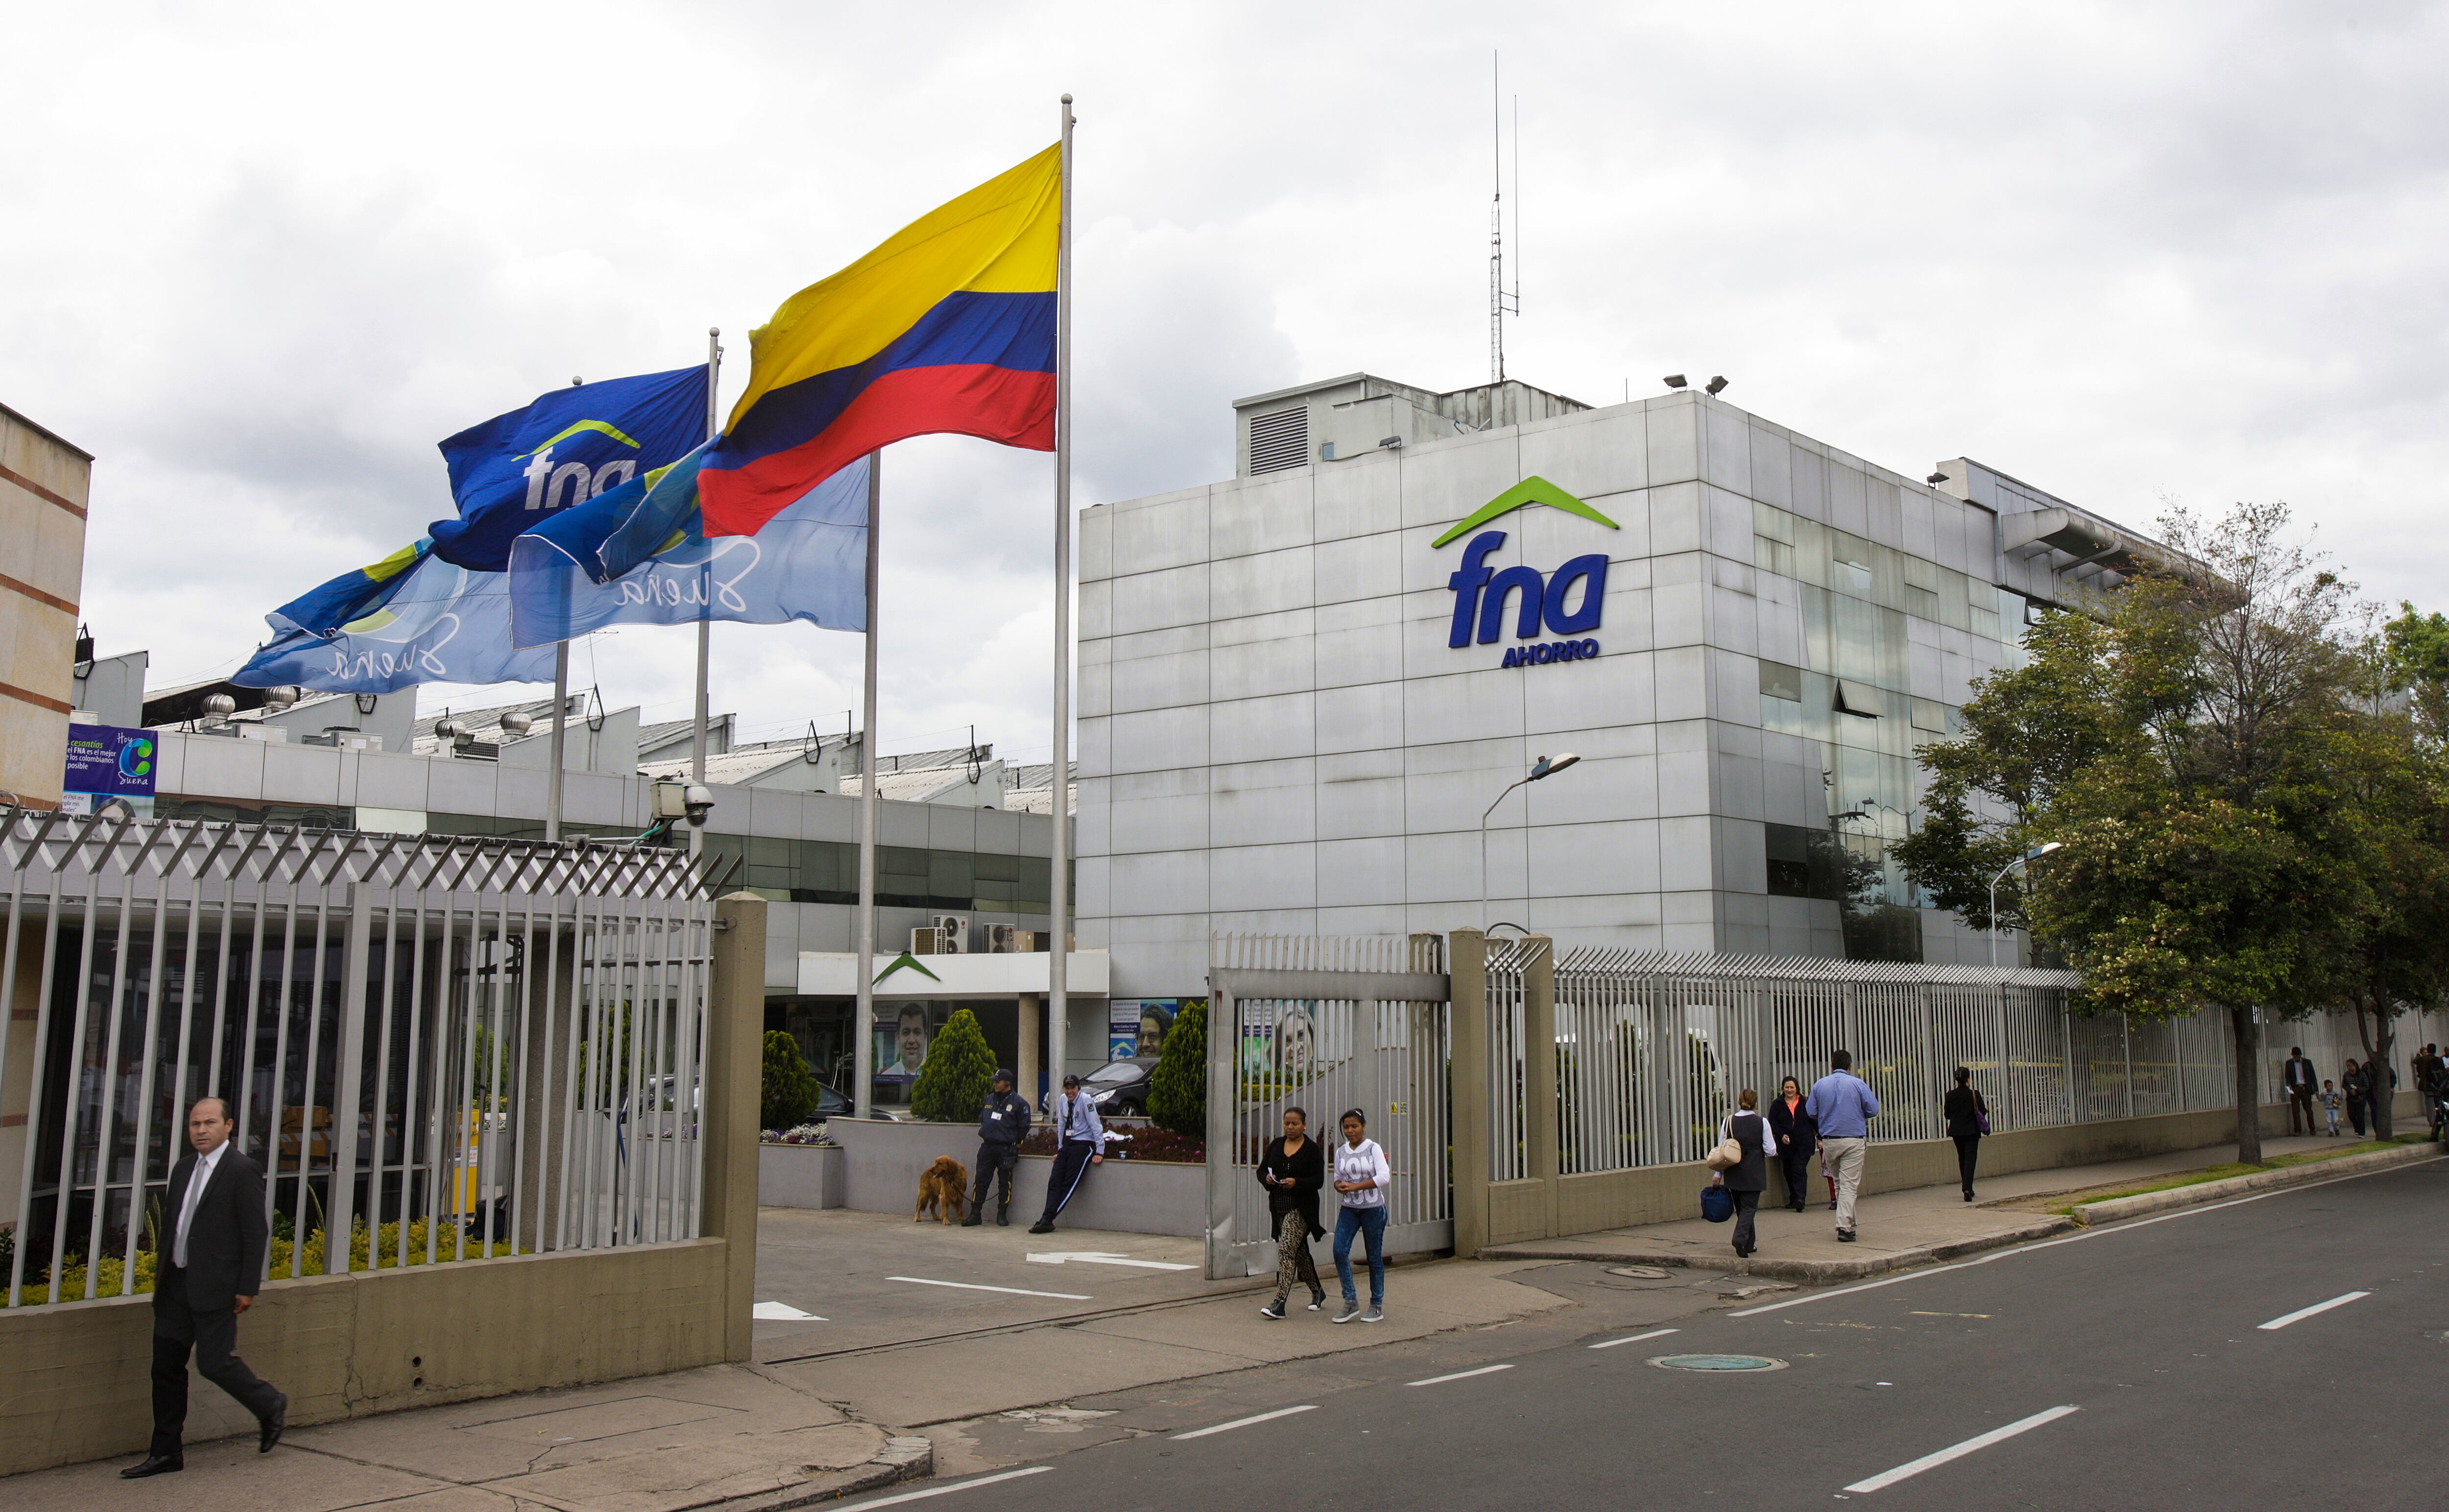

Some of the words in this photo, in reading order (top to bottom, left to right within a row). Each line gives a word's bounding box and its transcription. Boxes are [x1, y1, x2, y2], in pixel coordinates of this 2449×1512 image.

[523, 446, 637, 510] fna
[1448, 530, 1609, 648] fna
[1501, 638, 1599, 668] AHORRO
[71, 740, 103, 748] cesantías
[117, 732, 133, 747] Hoy
[79, 755, 114, 764] colombianos
